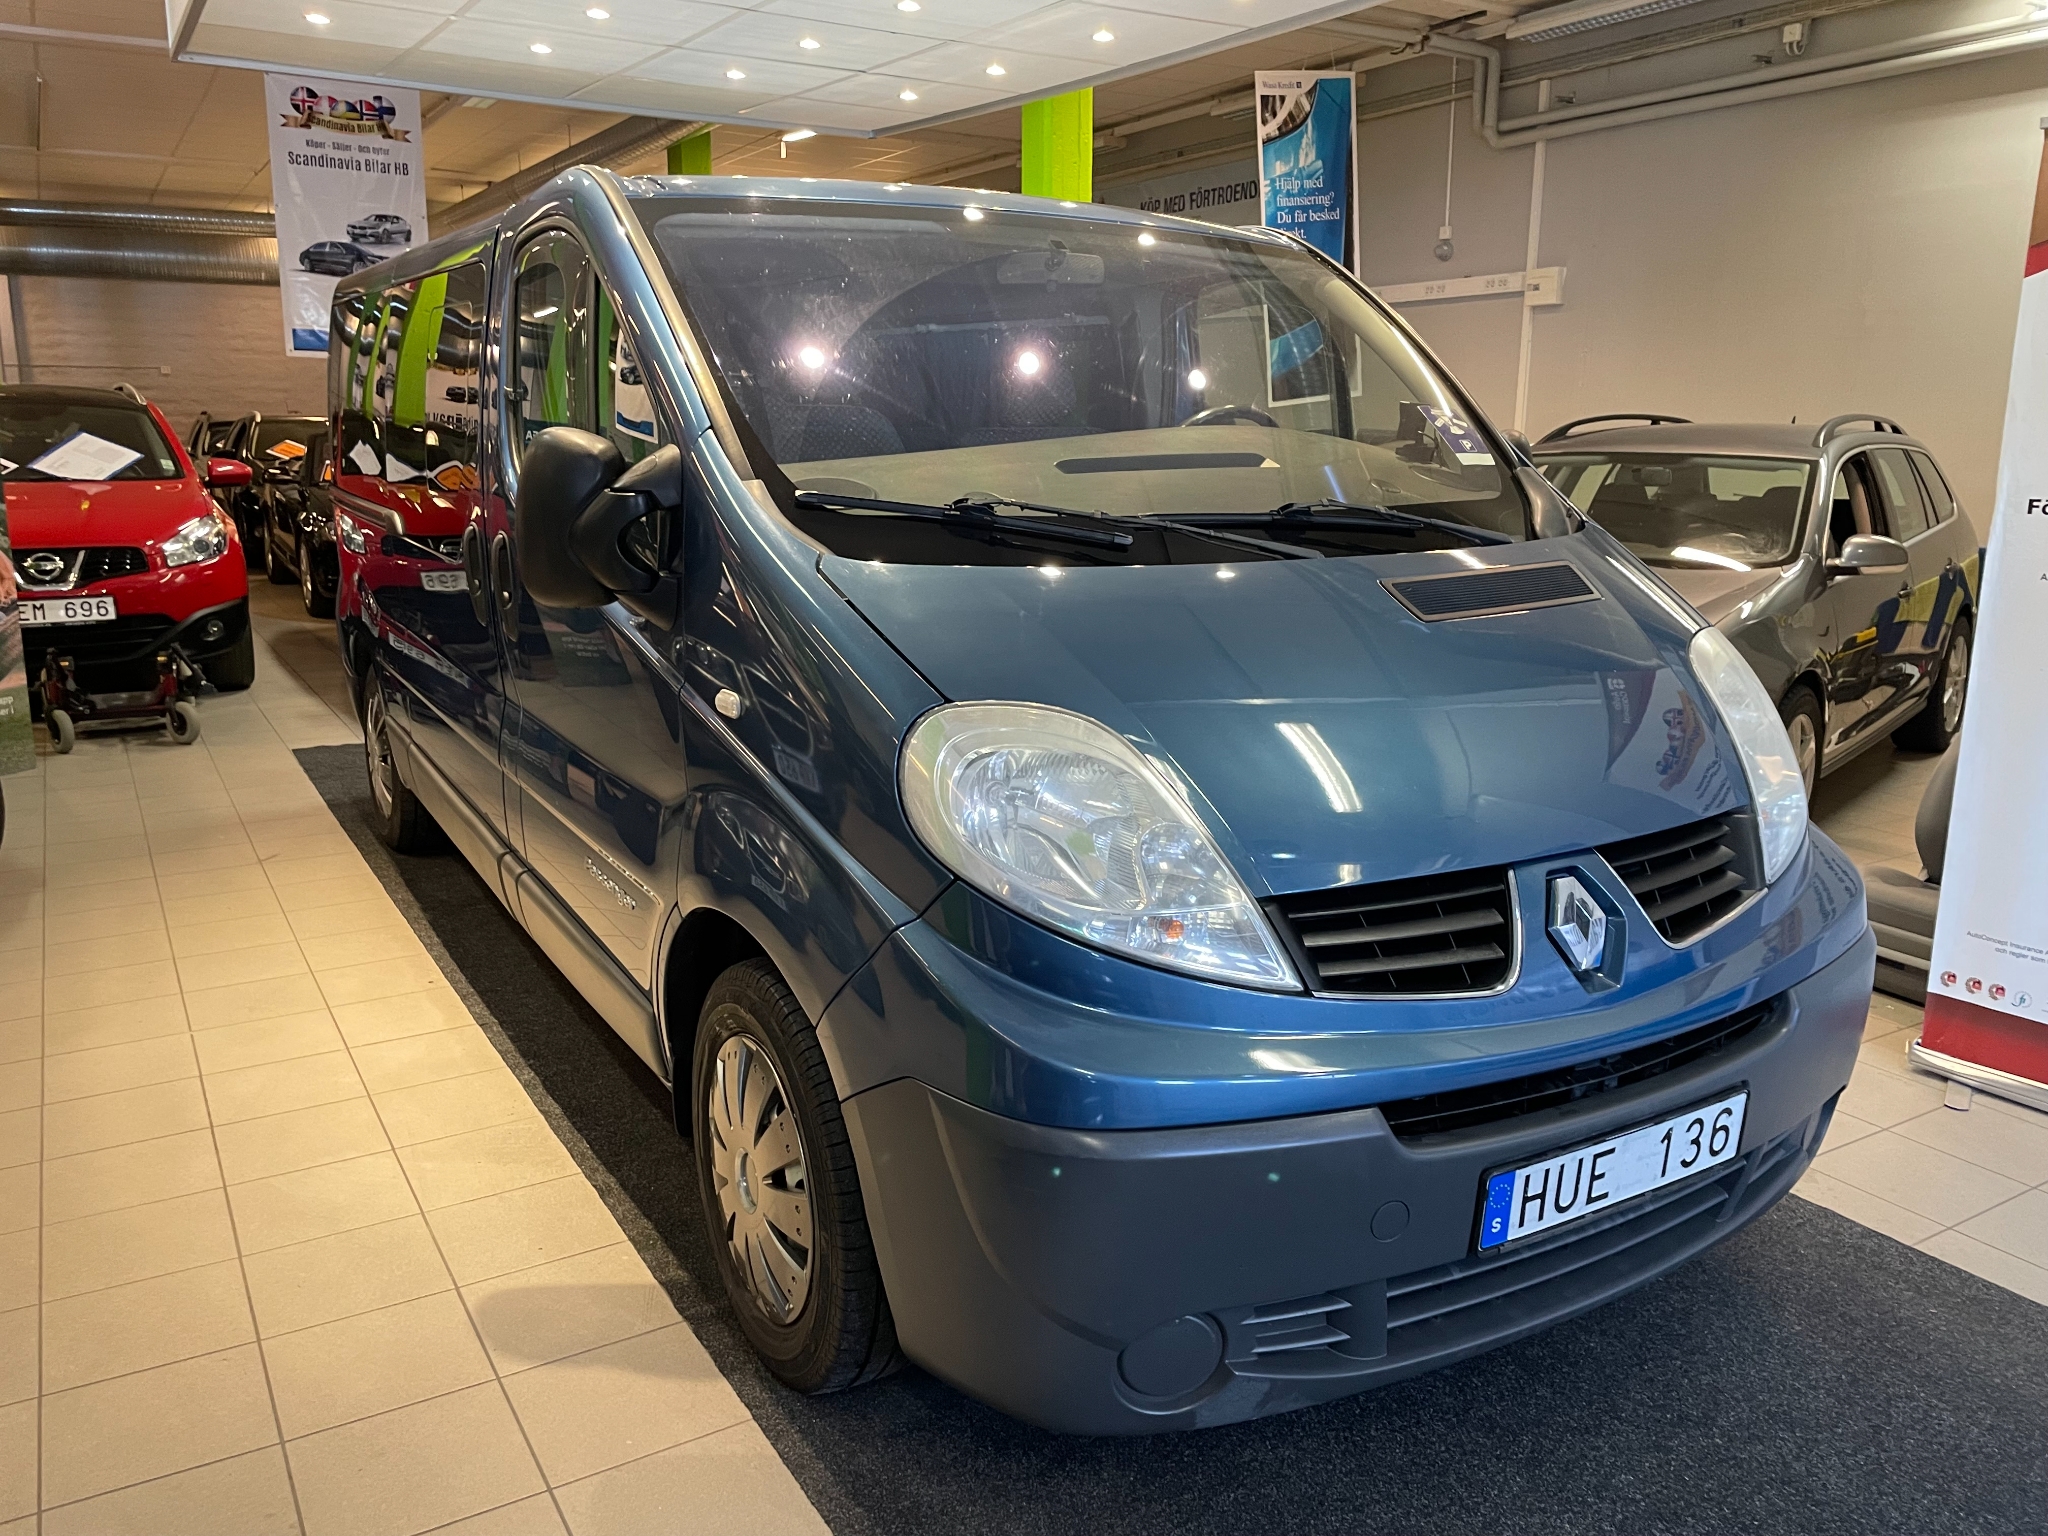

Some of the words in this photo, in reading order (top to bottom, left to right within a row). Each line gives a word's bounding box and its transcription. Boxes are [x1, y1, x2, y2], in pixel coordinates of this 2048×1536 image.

[357, 123, 375, 133] Bilar
[287, 150, 361, 172] Scandinavia
[364, 158, 392, 175] Bilar
[394, 162, 409, 176] HB
[1275, 176, 1301, 194] Hjälp
[1304, 176, 1323, 189] med
[1140, 196, 1160, 212] KÖP
[1163, 194, 1186, 213] MED
[1189, 179, 1260, 210] FÖRTROEND
[1276, 191, 1335, 207] finansiering?
[1277, 211, 1291, 224] Du
[1294, 209, 1307, 223] får
[1309, 207, 1340, 221] besked
[64, 600, 109, 618] 696
[1966, 931, 2008, 946] AutoConcept
[2010, 942, 2044, 955] Insurance
[1995, 947, 2007, 955] och
[2009, 950, 2029, 959] regler
[1518, 1147, 1617, 1229] HUE
[1660, 1107, 1733, 1178] 136
[1491, 1217, 1502, 1233] S
